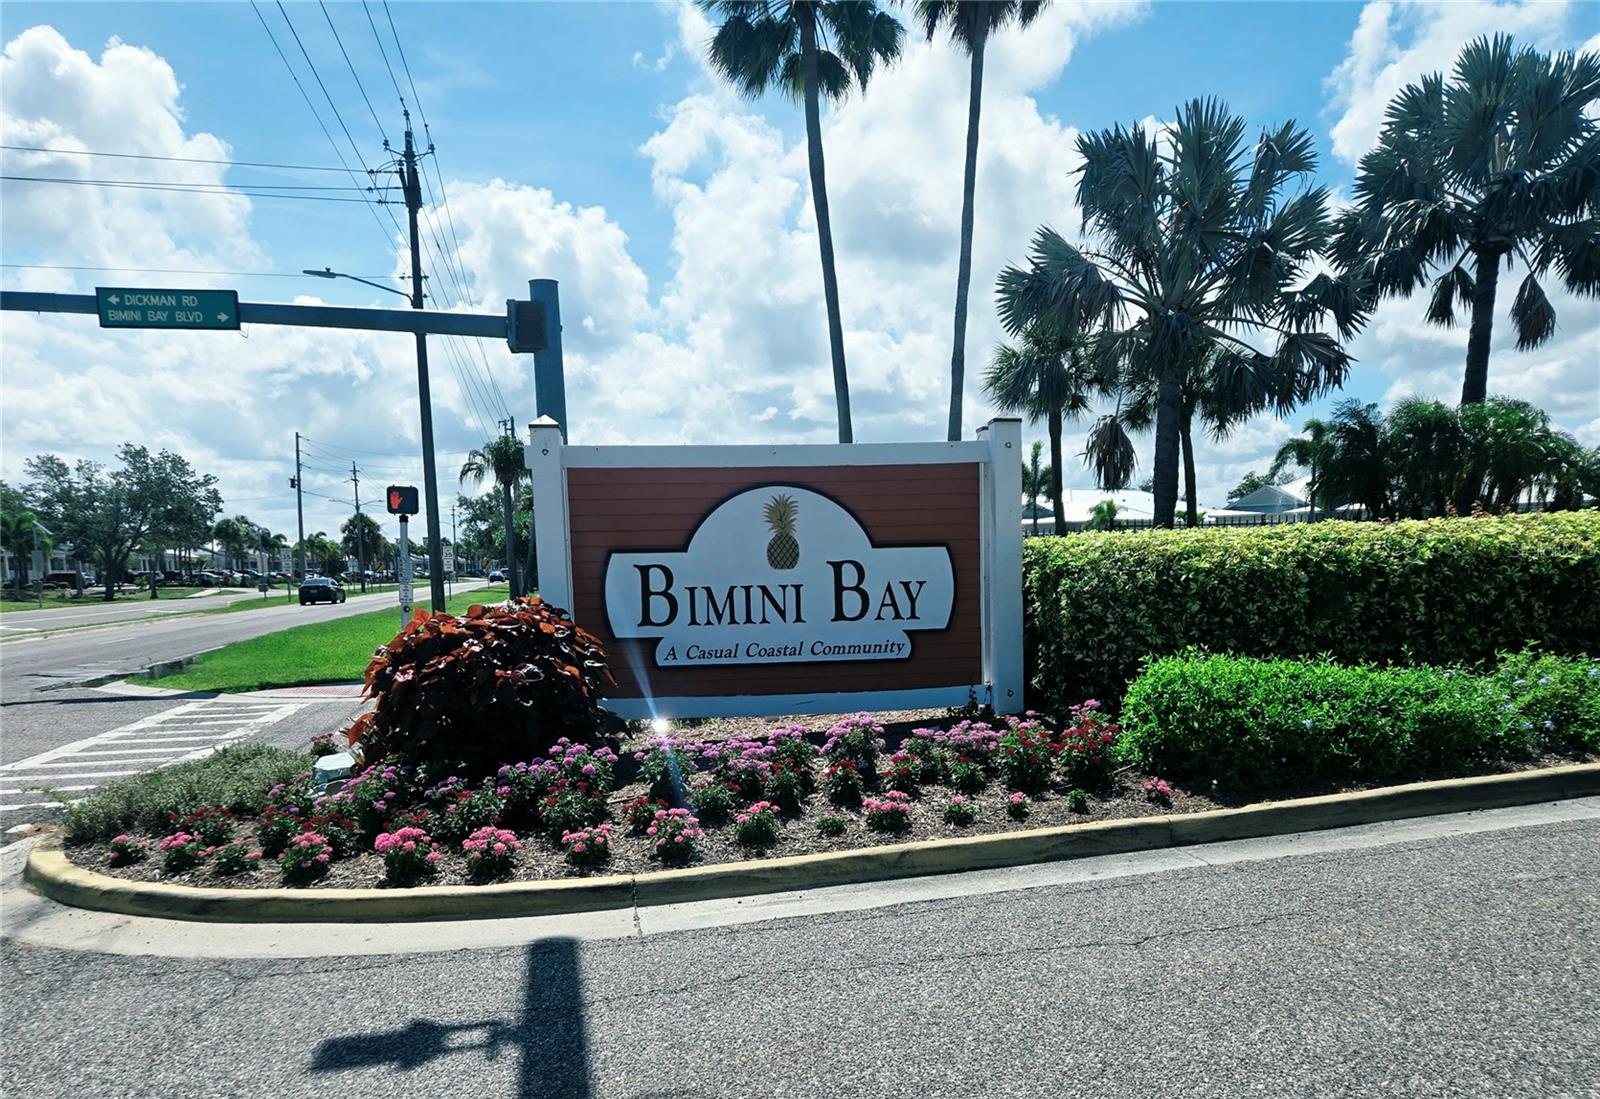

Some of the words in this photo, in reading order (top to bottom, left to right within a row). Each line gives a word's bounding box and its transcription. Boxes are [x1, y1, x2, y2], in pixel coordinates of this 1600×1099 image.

[124, 294, 176, 307] DICKMAN
[182, 295, 198, 307] RD
[108, 309, 141, 322] BIMINI
[147, 310, 168, 322] BAY
[175, 311, 203, 323] BLVD
[663, 647, 678, 660] A
[686, 645, 738, 660] Casual
[746, 642, 803, 658] Coastal
[810, 640, 905, 657] Community
